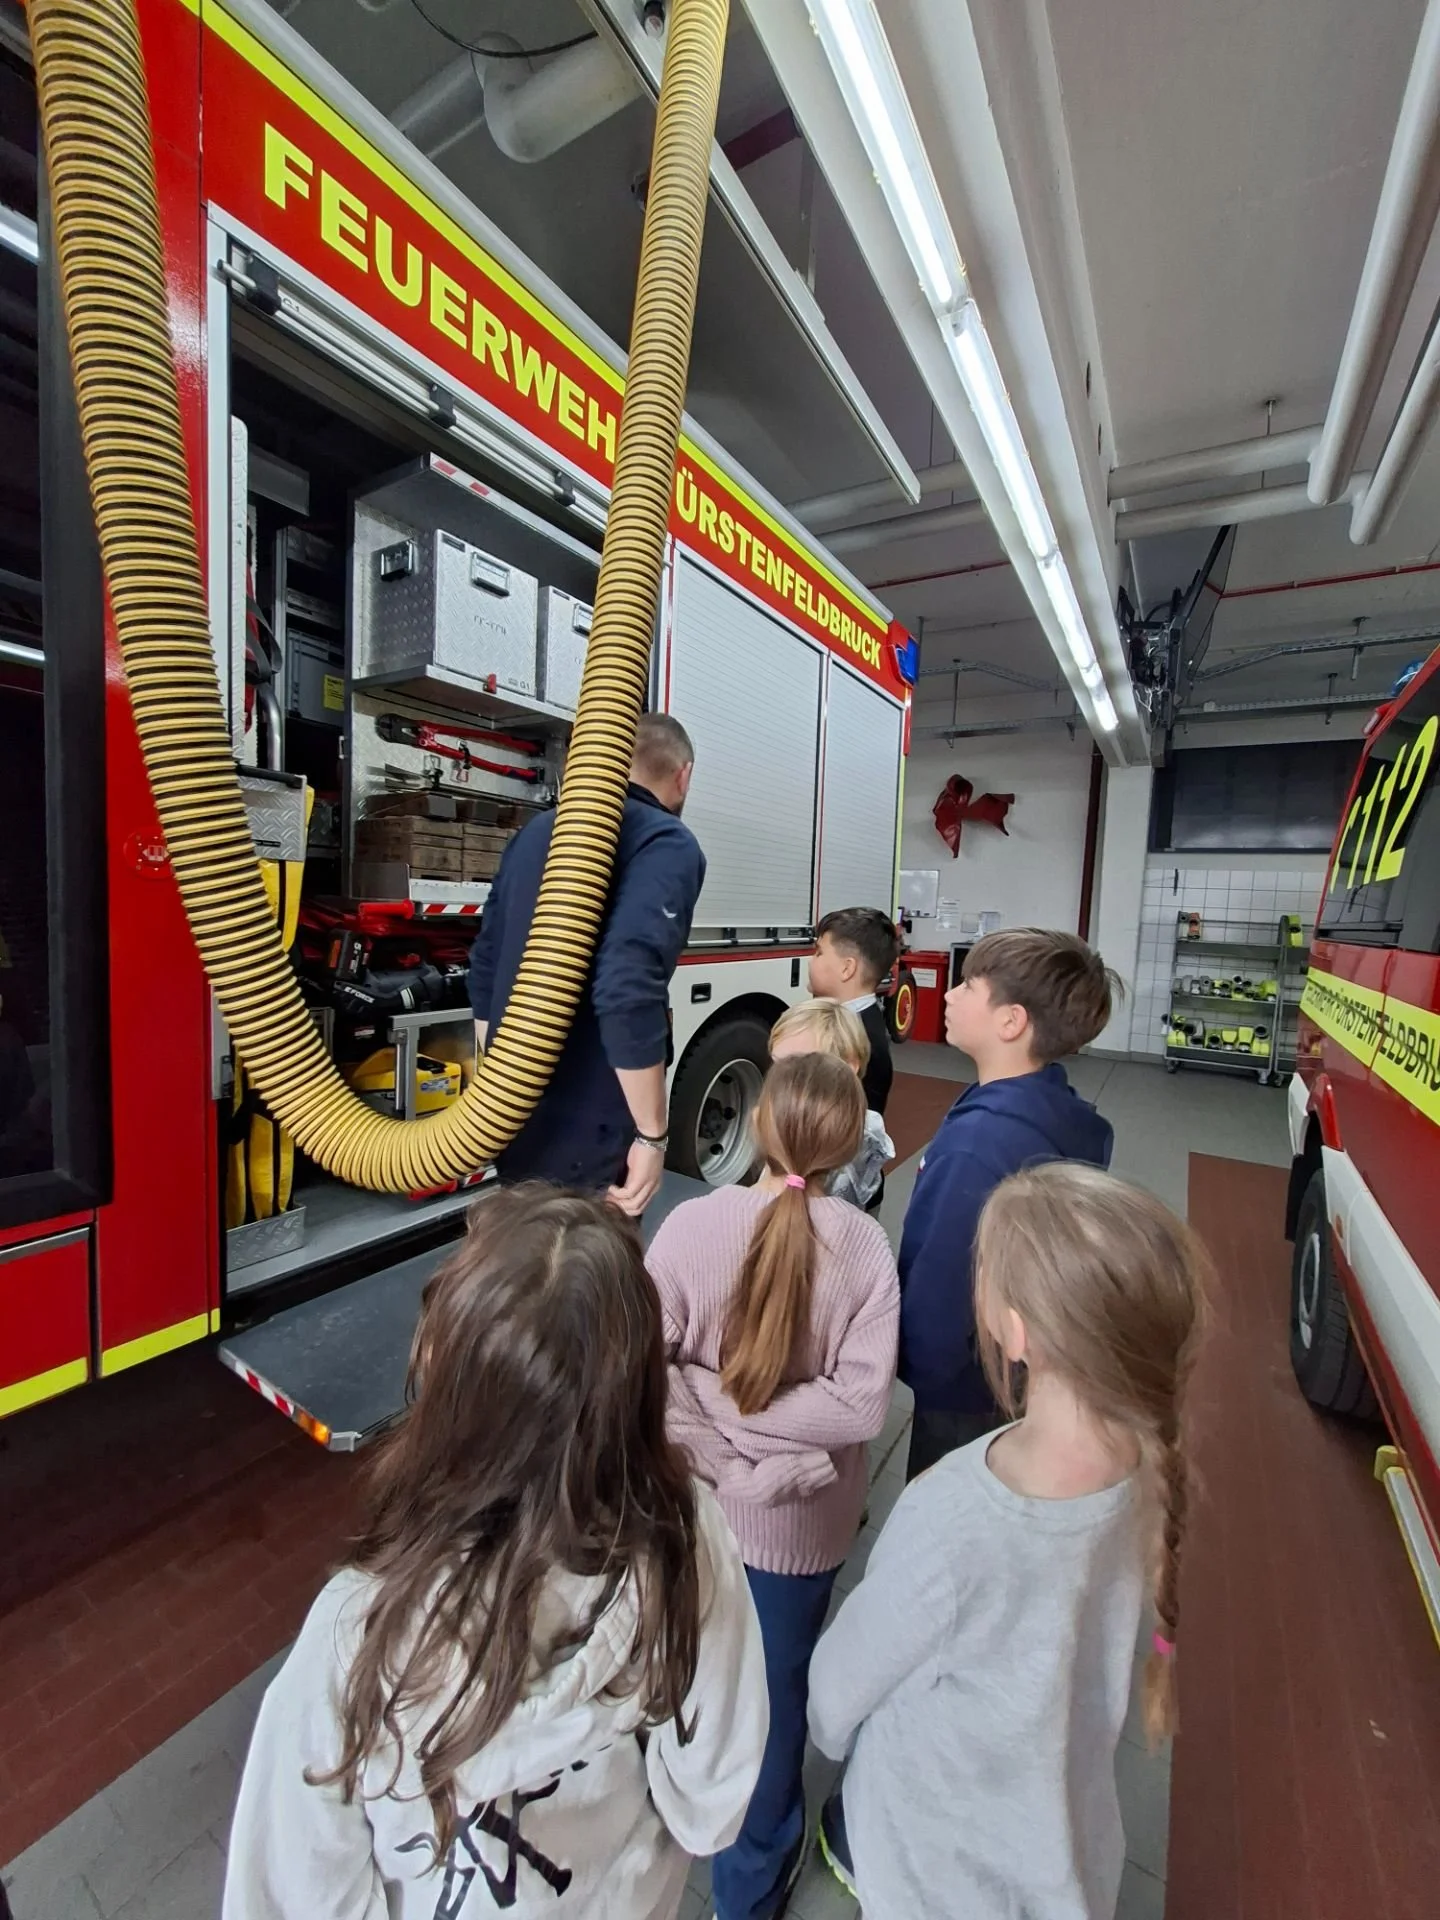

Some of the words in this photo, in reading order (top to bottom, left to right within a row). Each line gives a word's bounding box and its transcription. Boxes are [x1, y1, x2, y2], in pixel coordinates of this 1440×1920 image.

[264, 121, 616, 463] FEUERWEH
[676, 466, 882, 670] ÜRSTENFELDBRUCK
[1331, 987, 1440, 1092] FÜRSTENFELDBRU
